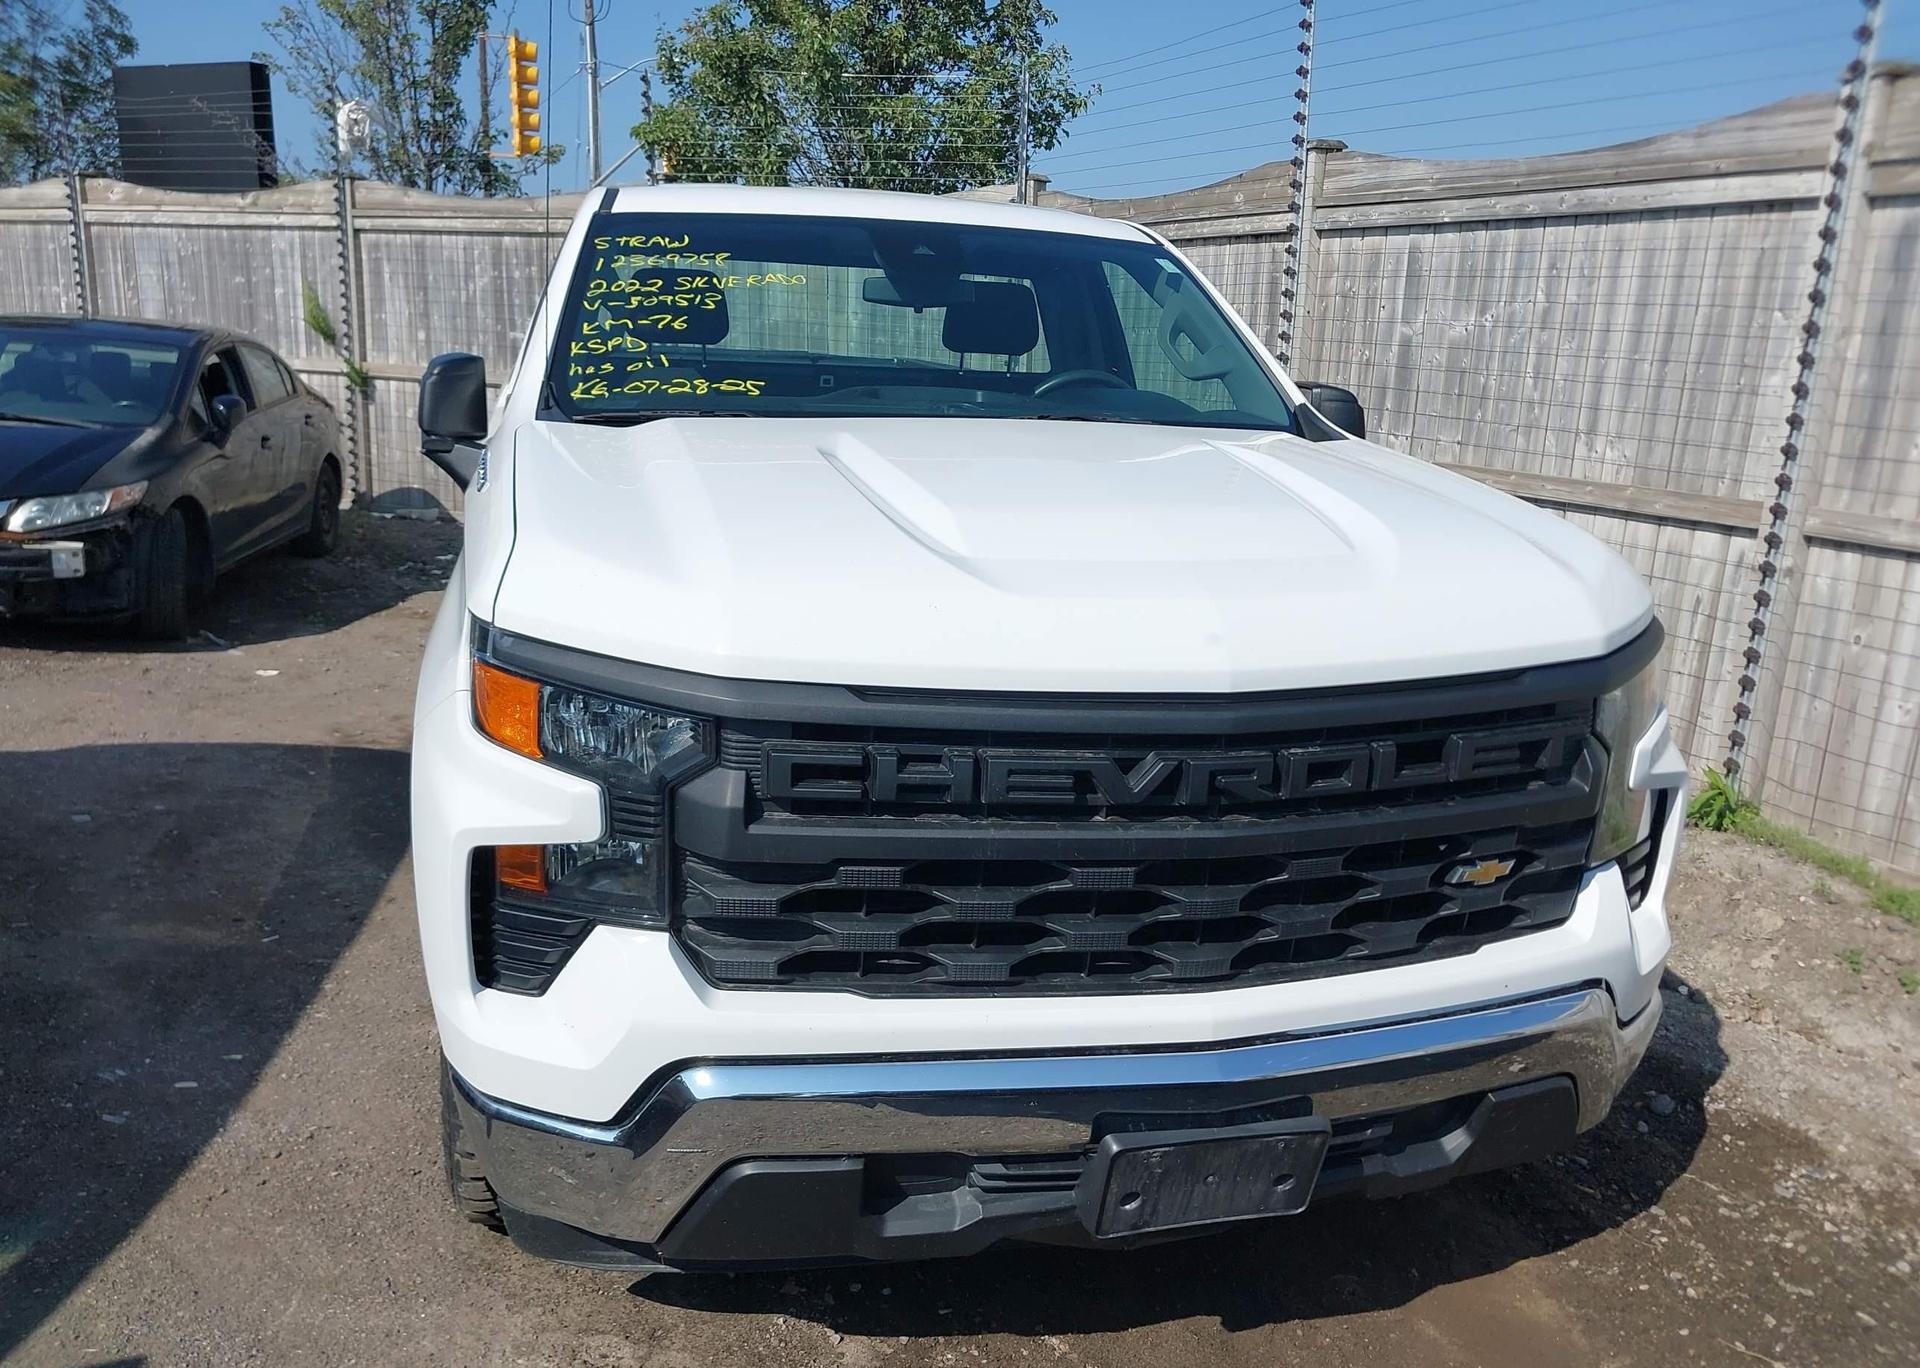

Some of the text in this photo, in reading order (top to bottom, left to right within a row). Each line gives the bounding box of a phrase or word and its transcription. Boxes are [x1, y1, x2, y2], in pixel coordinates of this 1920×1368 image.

[594, 234, 690, 249] STRAW
[586, 279, 664, 297] 2022
[582, 315, 688, 335] KM-76
[570, 336, 648, 357] KSPD
[626, 353, 670, 372] oil
[760, 720, 1588, 806] CHEVROLET
